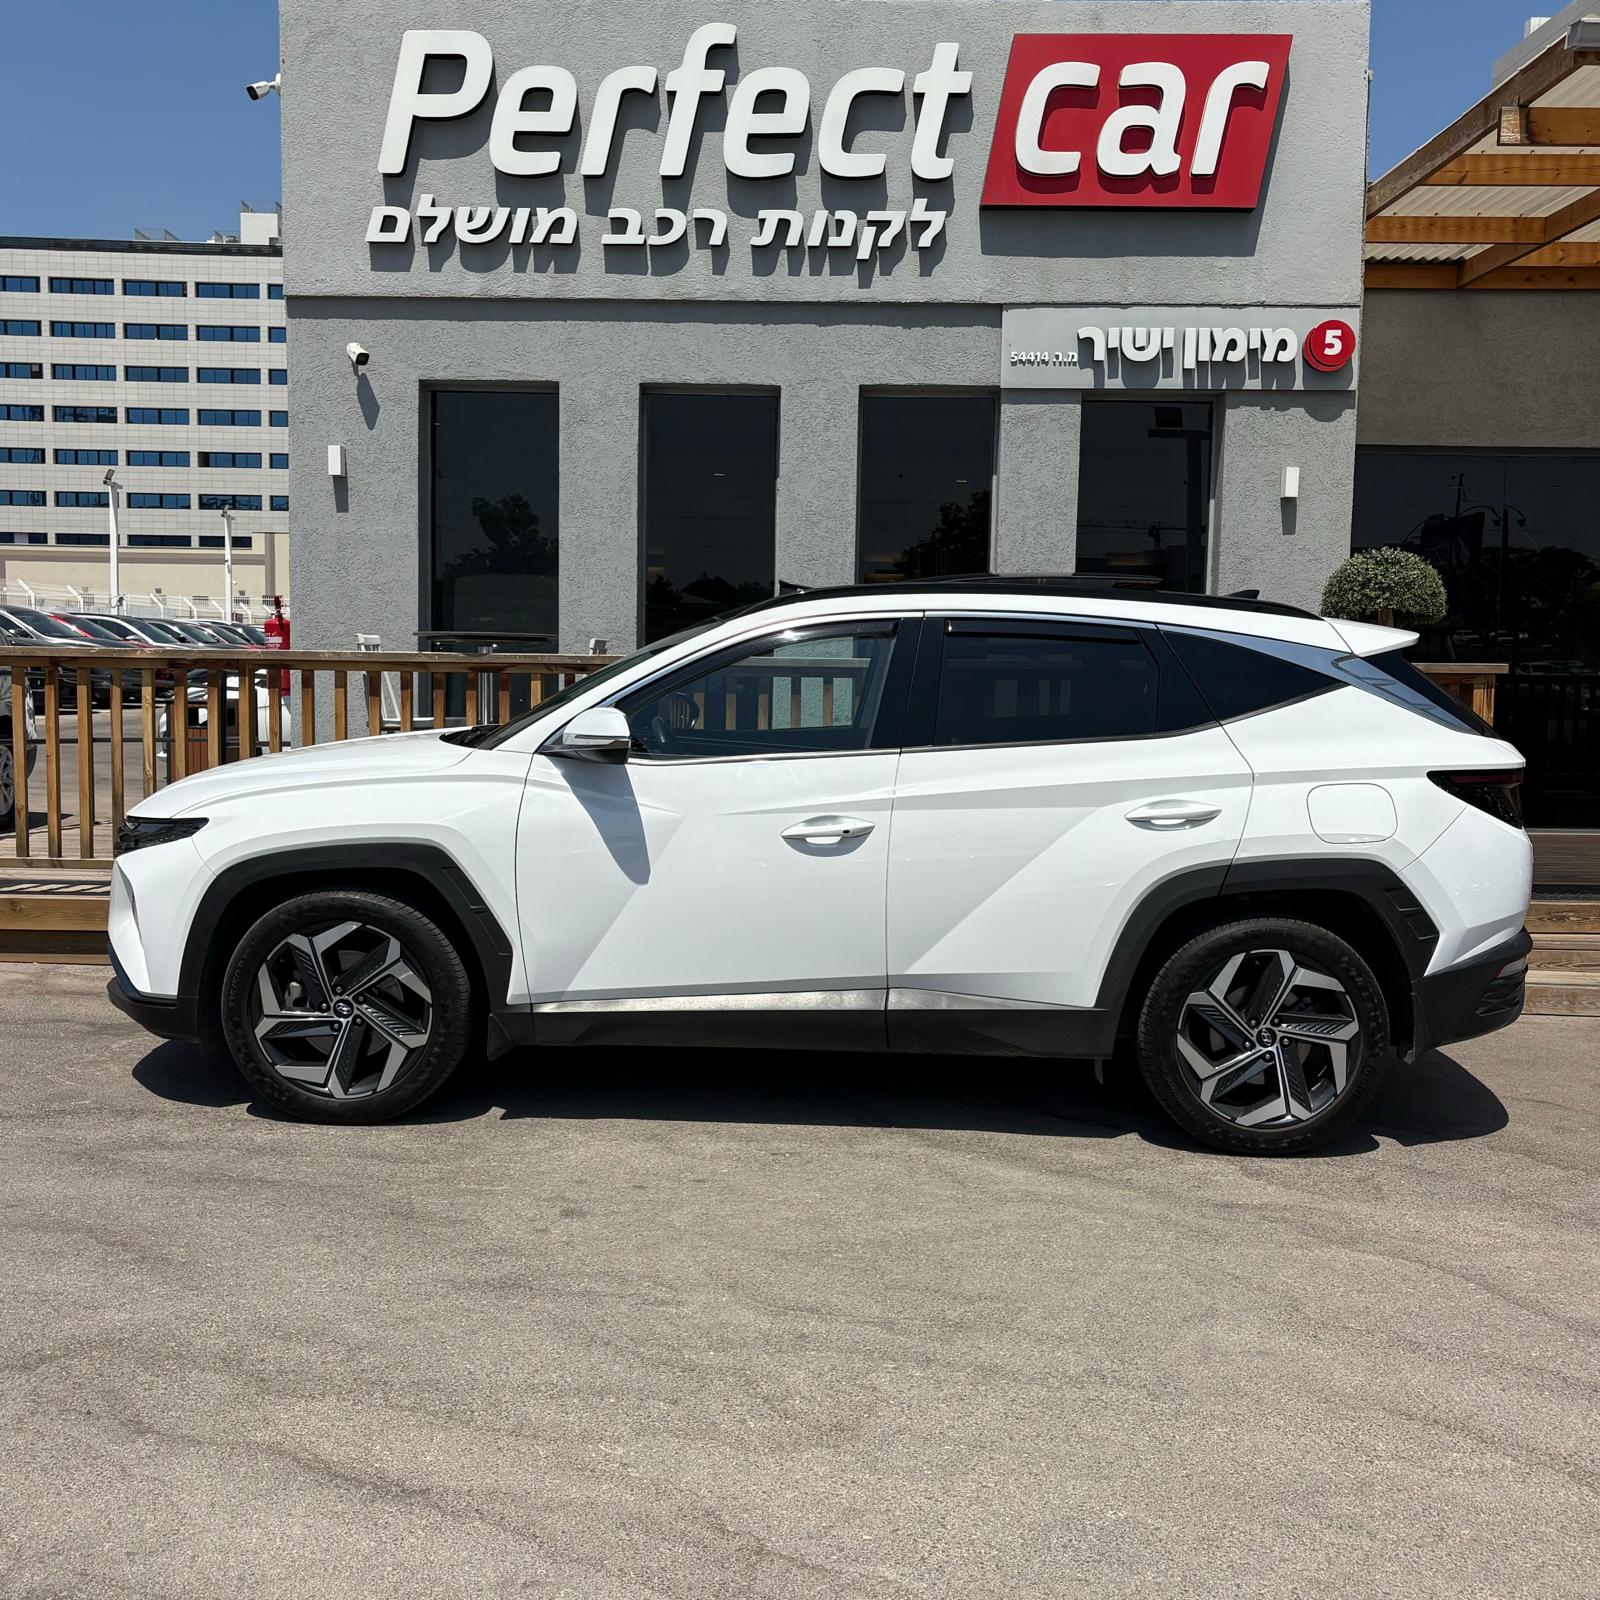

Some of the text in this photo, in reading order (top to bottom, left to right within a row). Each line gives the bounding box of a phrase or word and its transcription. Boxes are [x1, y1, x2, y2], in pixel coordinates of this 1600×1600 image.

[378, 23, 1270, 179] Perfect car
[366, 193, 947, 260] לקנות רכב מושלם
[1010, 351, 1049, 362] 54414
[1077, 326, 1298, 369] מימון ישיר
[1323, 329, 1343, 356] 5
